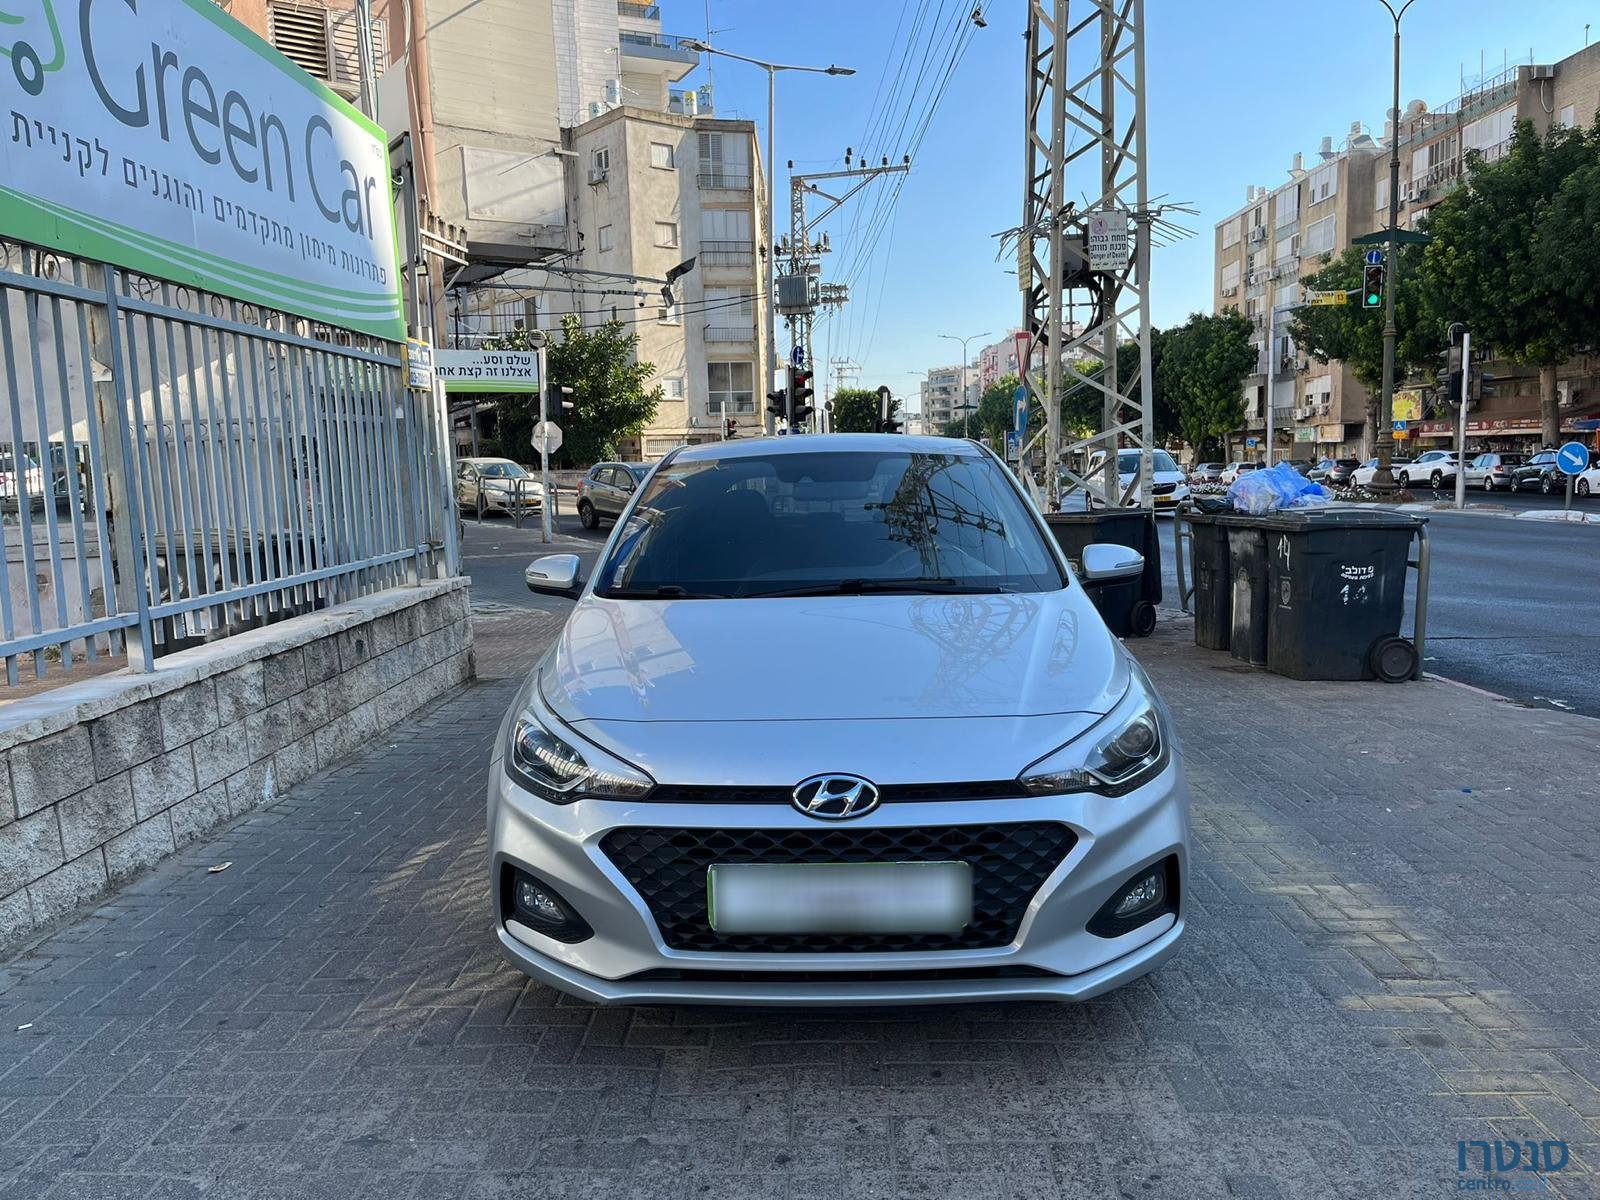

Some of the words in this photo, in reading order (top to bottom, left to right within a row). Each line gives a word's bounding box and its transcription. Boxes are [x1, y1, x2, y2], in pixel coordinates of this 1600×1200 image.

[79, 0, 296, 203] Green
[305, 114, 377, 241] Car
[10, 110, 109, 178] לקניית
[122, 157, 205, 214] והוגנים
[213, 195, 295, 250] מתקדמים
[300, 232, 337, 266] מימון
[1090, 252, 1106, 261] Danger
[341, 250, 387, 285] פתרונות
[472, 355, 503, 365] וסע...
[485, 367, 499, 376] זה
[501, 366, 532, 377] אצלנו
[506, 355, 531, 366] שלם
[458, 366, 482, 379] קצת
